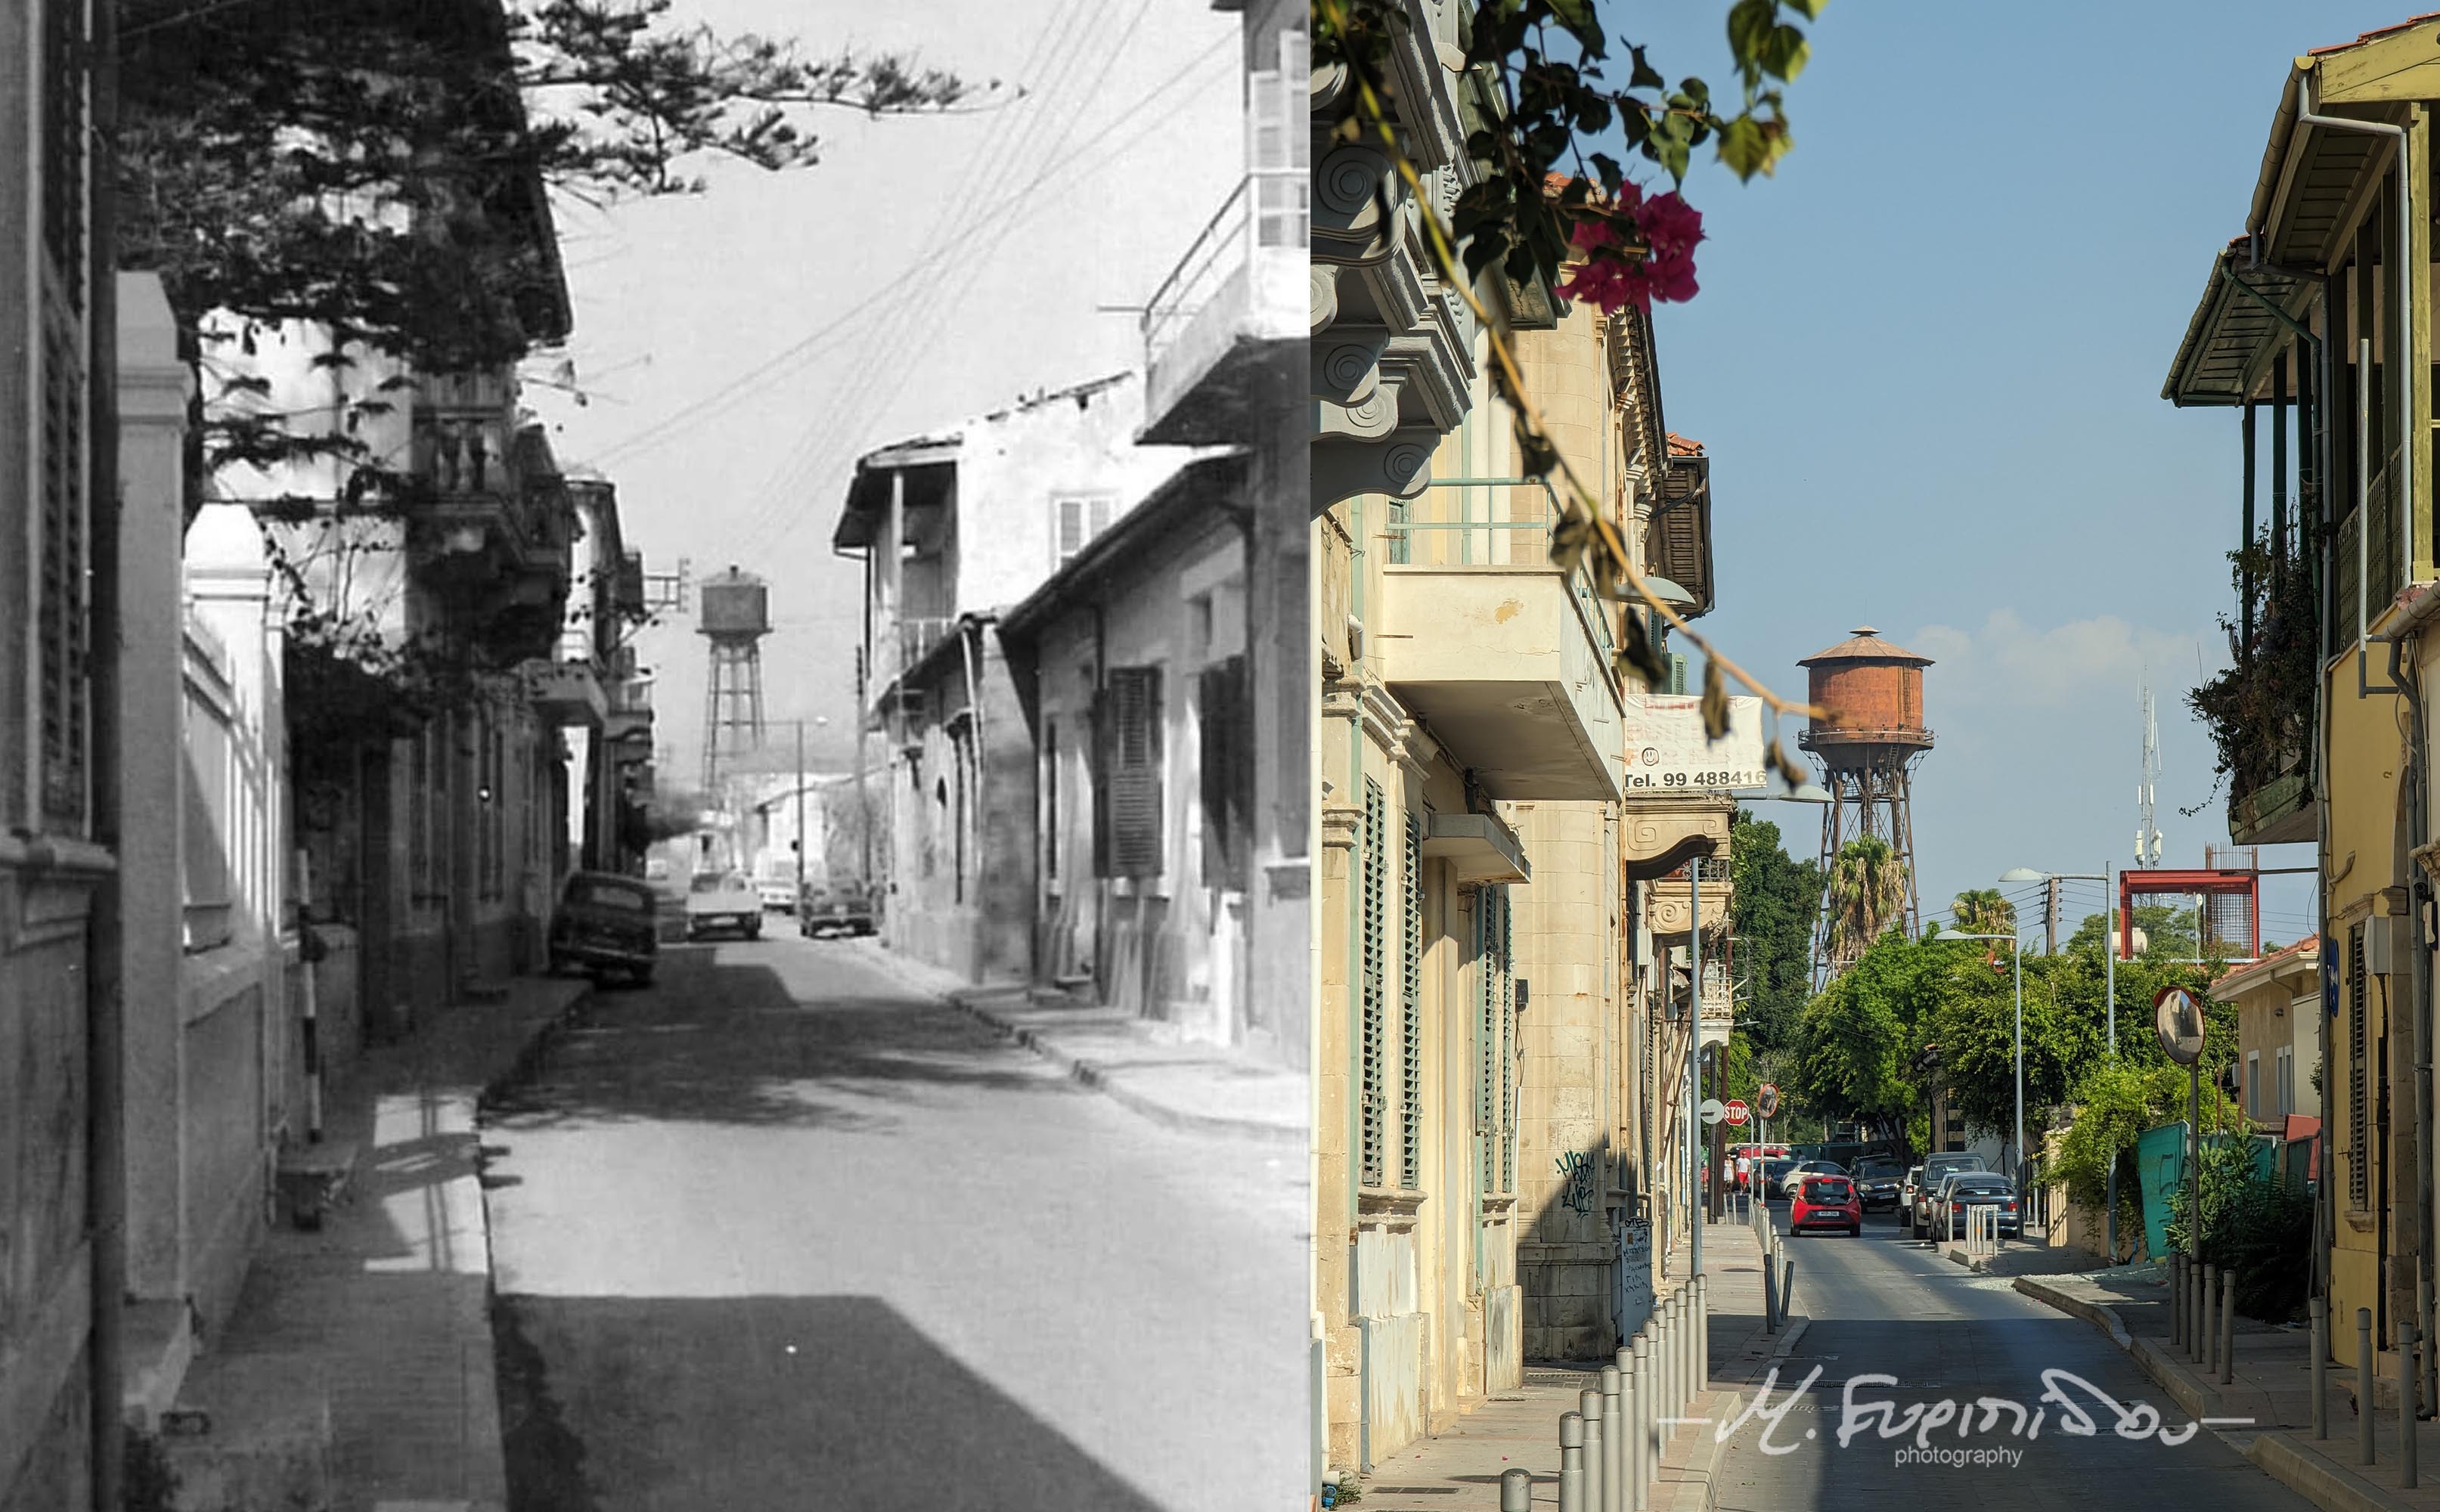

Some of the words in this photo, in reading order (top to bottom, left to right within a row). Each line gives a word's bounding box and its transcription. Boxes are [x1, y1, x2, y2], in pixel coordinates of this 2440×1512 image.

[1626, 773, 1656, 788] Tel.
[1663, 772, 1687, 787] 99
[1694, 770, 1767, 786] 488416
[1724, 1106, 1747, 1120] STOP
